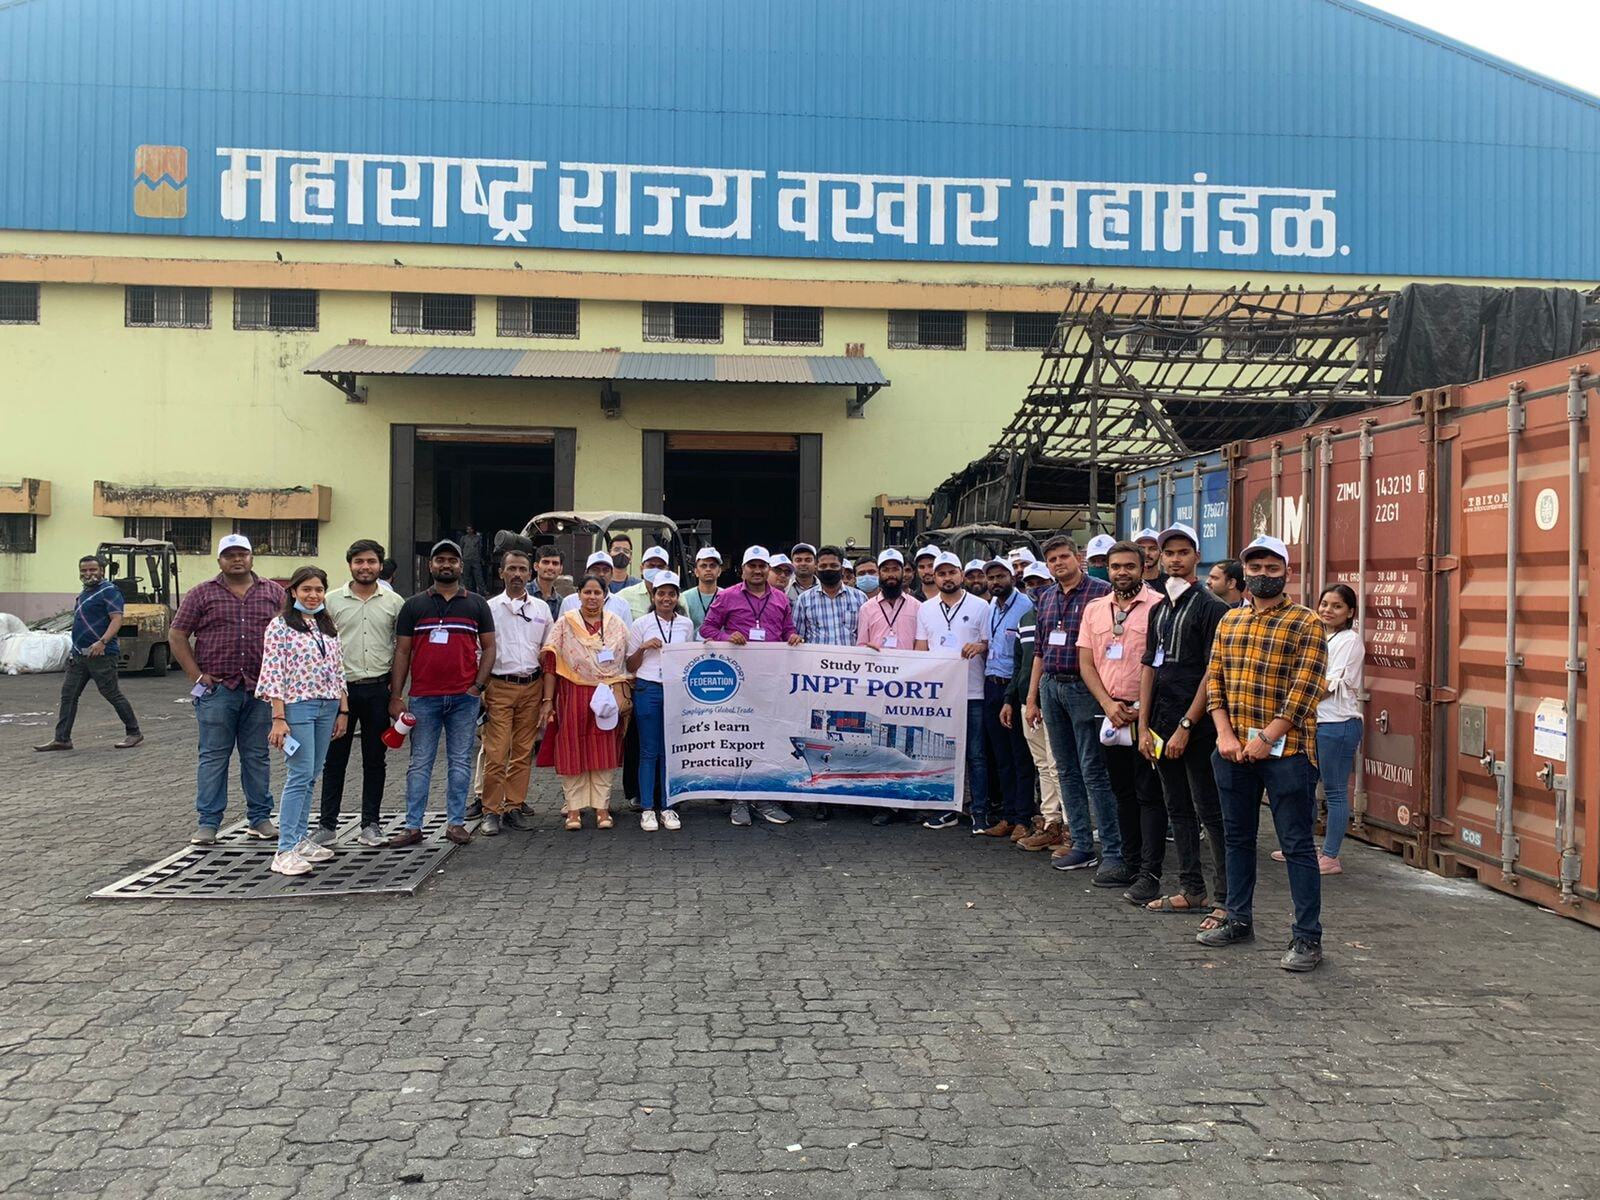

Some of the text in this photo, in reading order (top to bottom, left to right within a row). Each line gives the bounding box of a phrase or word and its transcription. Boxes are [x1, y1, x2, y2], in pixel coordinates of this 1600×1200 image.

[216, 147, 1351, 258] महाराष्ट्र राज्य वखार महामंडळ.
[1336, 481, 1361, 501] ZIMU
[1375, 474, 1412, 496] 143219
[1468, 492, 1508, 507] TRITON
[1375, 502, 1399, 522] 22G1
[1402, 571, 1409, 584] kg
[1395, 596, 1403, 608] kg
[1401, 621, 1408, 633] kg
[1374, 644, 1387, 655] 33.1
[718, 654, 745, 682] EXPORT
[820, 658, 899, 674] Study Tour
[689, 677, 734, 687] FEDERATION
[789, 673, 944, 700] JNPT PORT
[714, 705, 736, 714] Global
[736, 706, 754, 714] Trade
[885, 705, 952, 718] MUMBAI
[681, 720, 750, 734] Let's learn
[671, 739, 765, 754] Import Export
[681, 756, 753, 769] Practically
[1364, 758, 1413, 787] WWW.ZIM.COM
